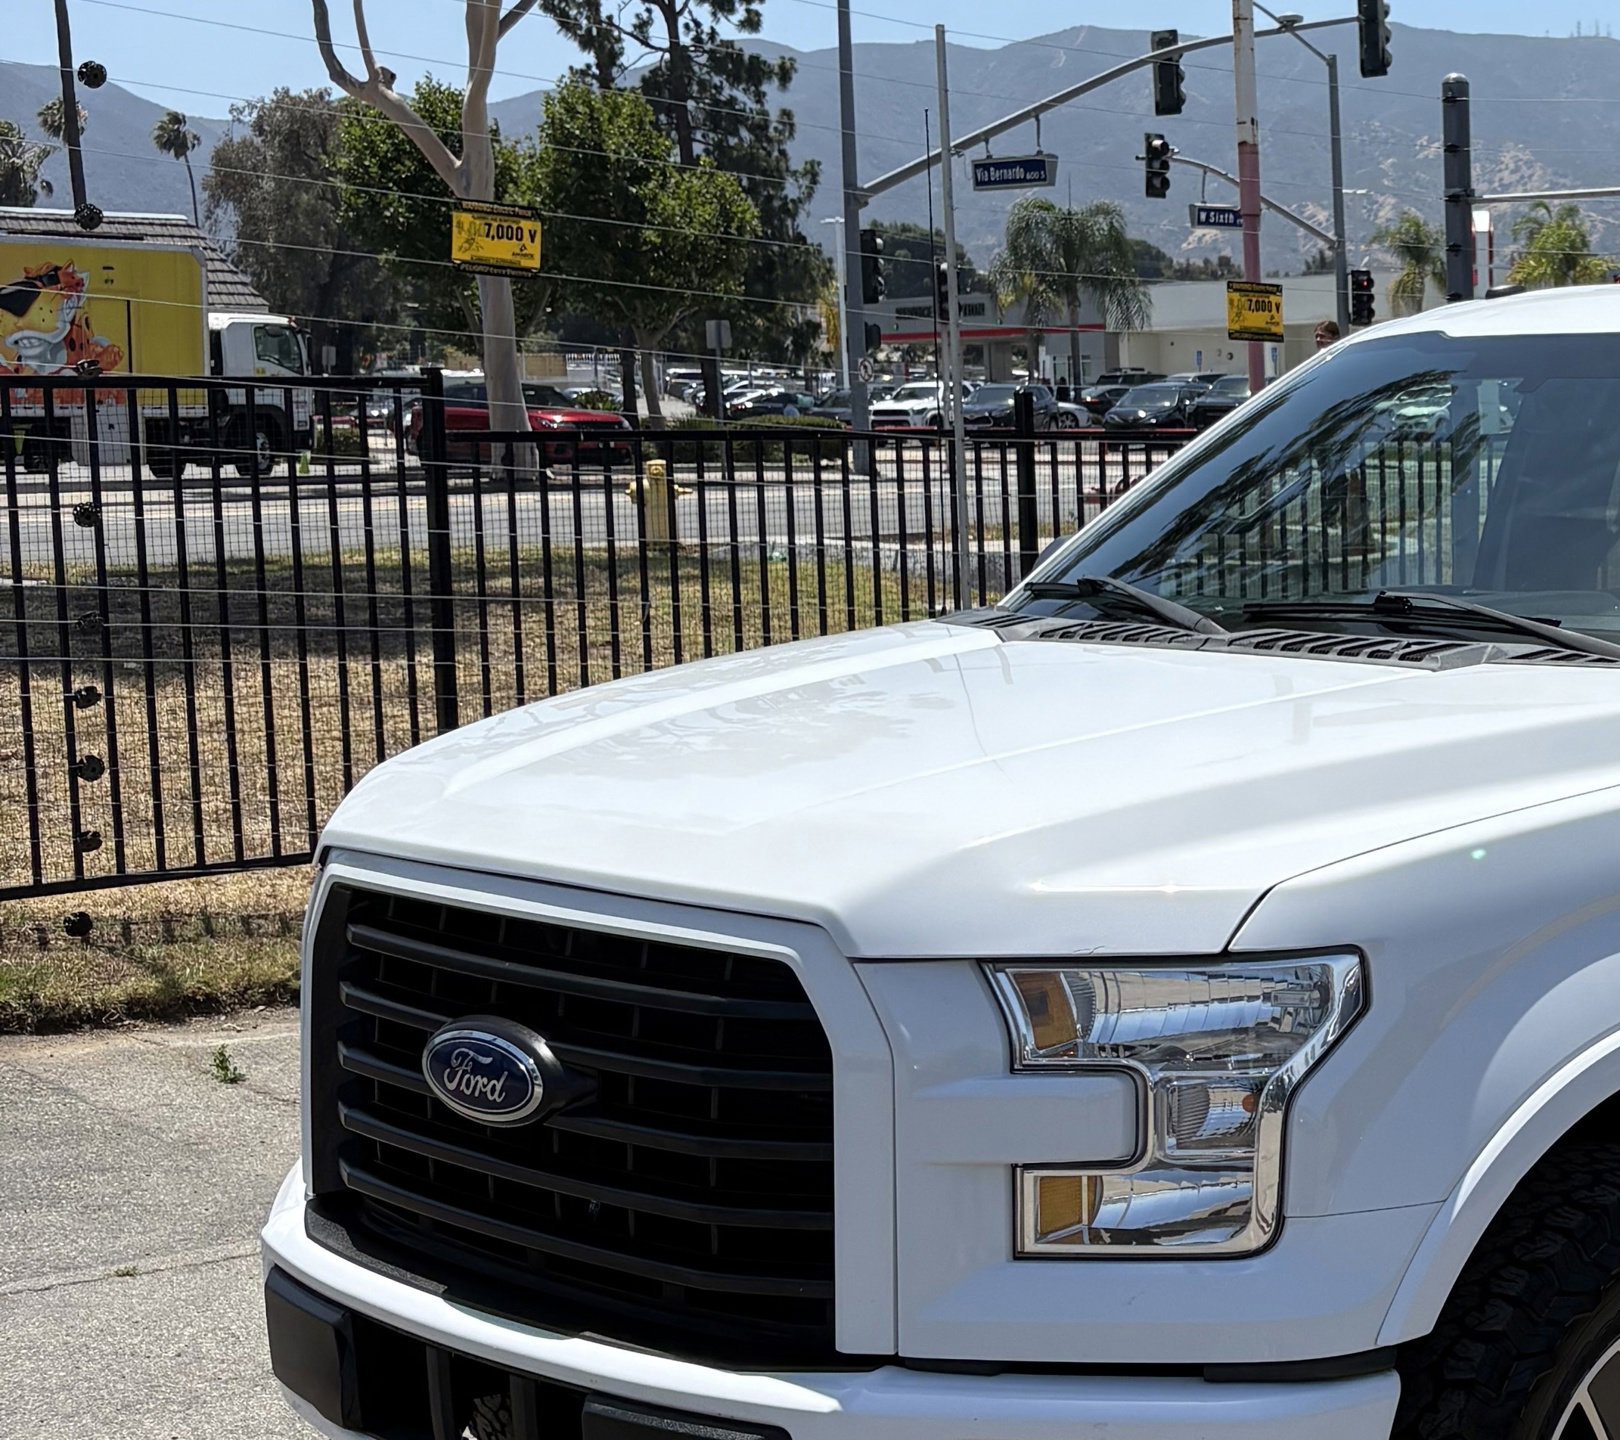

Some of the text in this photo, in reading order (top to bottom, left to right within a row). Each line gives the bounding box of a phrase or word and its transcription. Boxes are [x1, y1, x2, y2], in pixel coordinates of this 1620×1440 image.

[976, 167, 989, 182] Via
[989, 165, 1025, 182] Bernardo
[1200, 211, 1207, 223] W
[1209, 211, 1235, 224] Sixth
[484, 222, 537, 244] 7,000 V
[1247, 298, 1281, 314] 7,000 V
[443, 1047, 508, 1102] Ford
